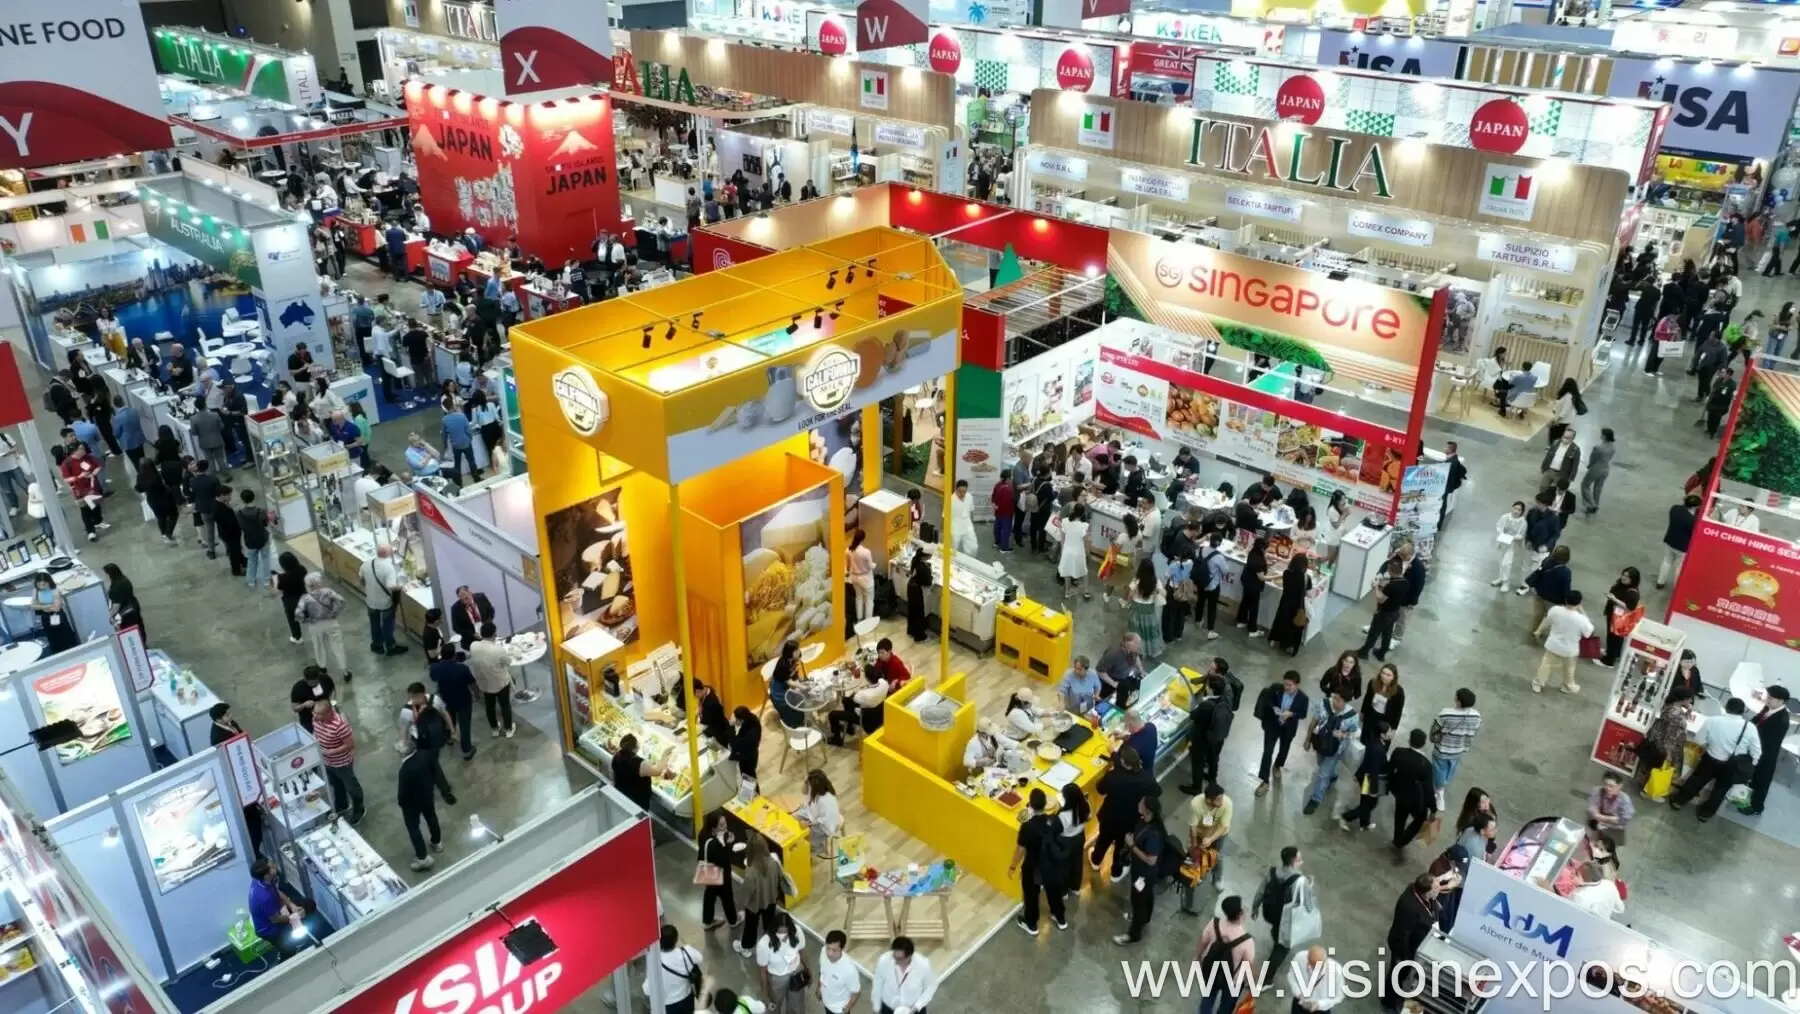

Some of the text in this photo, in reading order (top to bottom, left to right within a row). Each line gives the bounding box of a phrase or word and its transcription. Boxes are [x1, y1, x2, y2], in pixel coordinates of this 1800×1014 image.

[41, 18, 125, 42] FOOD
[820, 34, 846, 46] JAPAN
[864, 15, 888, 44] W
[173, 40, 225, 80] ITALIA
[931, 48, 959, 61] JAPAN
[1153, 58, 1180, 70] GREAT
[514, 50, 541, 86] X
[1059, 66, 1092, 79] JAPAN
[1279, 94, 1321, 111] JAPAN
[0, 112, 33, 157] Y
[1474, 119, 1525, 138] JAPAN
[436, 123, 492, 162] JAPAN
[1184, 117, 1395, 199] ITALIA
[545, 167, 607, 196] JAPAN
[170, 216, 225, 254] AUSTRALIA
[1352, 218, 1430, 241] COMEX COMPANY
[1491, 250, 1531, 265] TARTUFI
[1504, 242, 1550, 258] SULPIZIO
[1159, 264, 1179, 281] SG
[1703, 527, 1719, 538] OH
[1720, 532, 1747, 546] CHIN
[1747, 539, 1776, 554] HING
[1479, 923, 1512, 945] Albert
[1515, 940, 1529, 953] de
